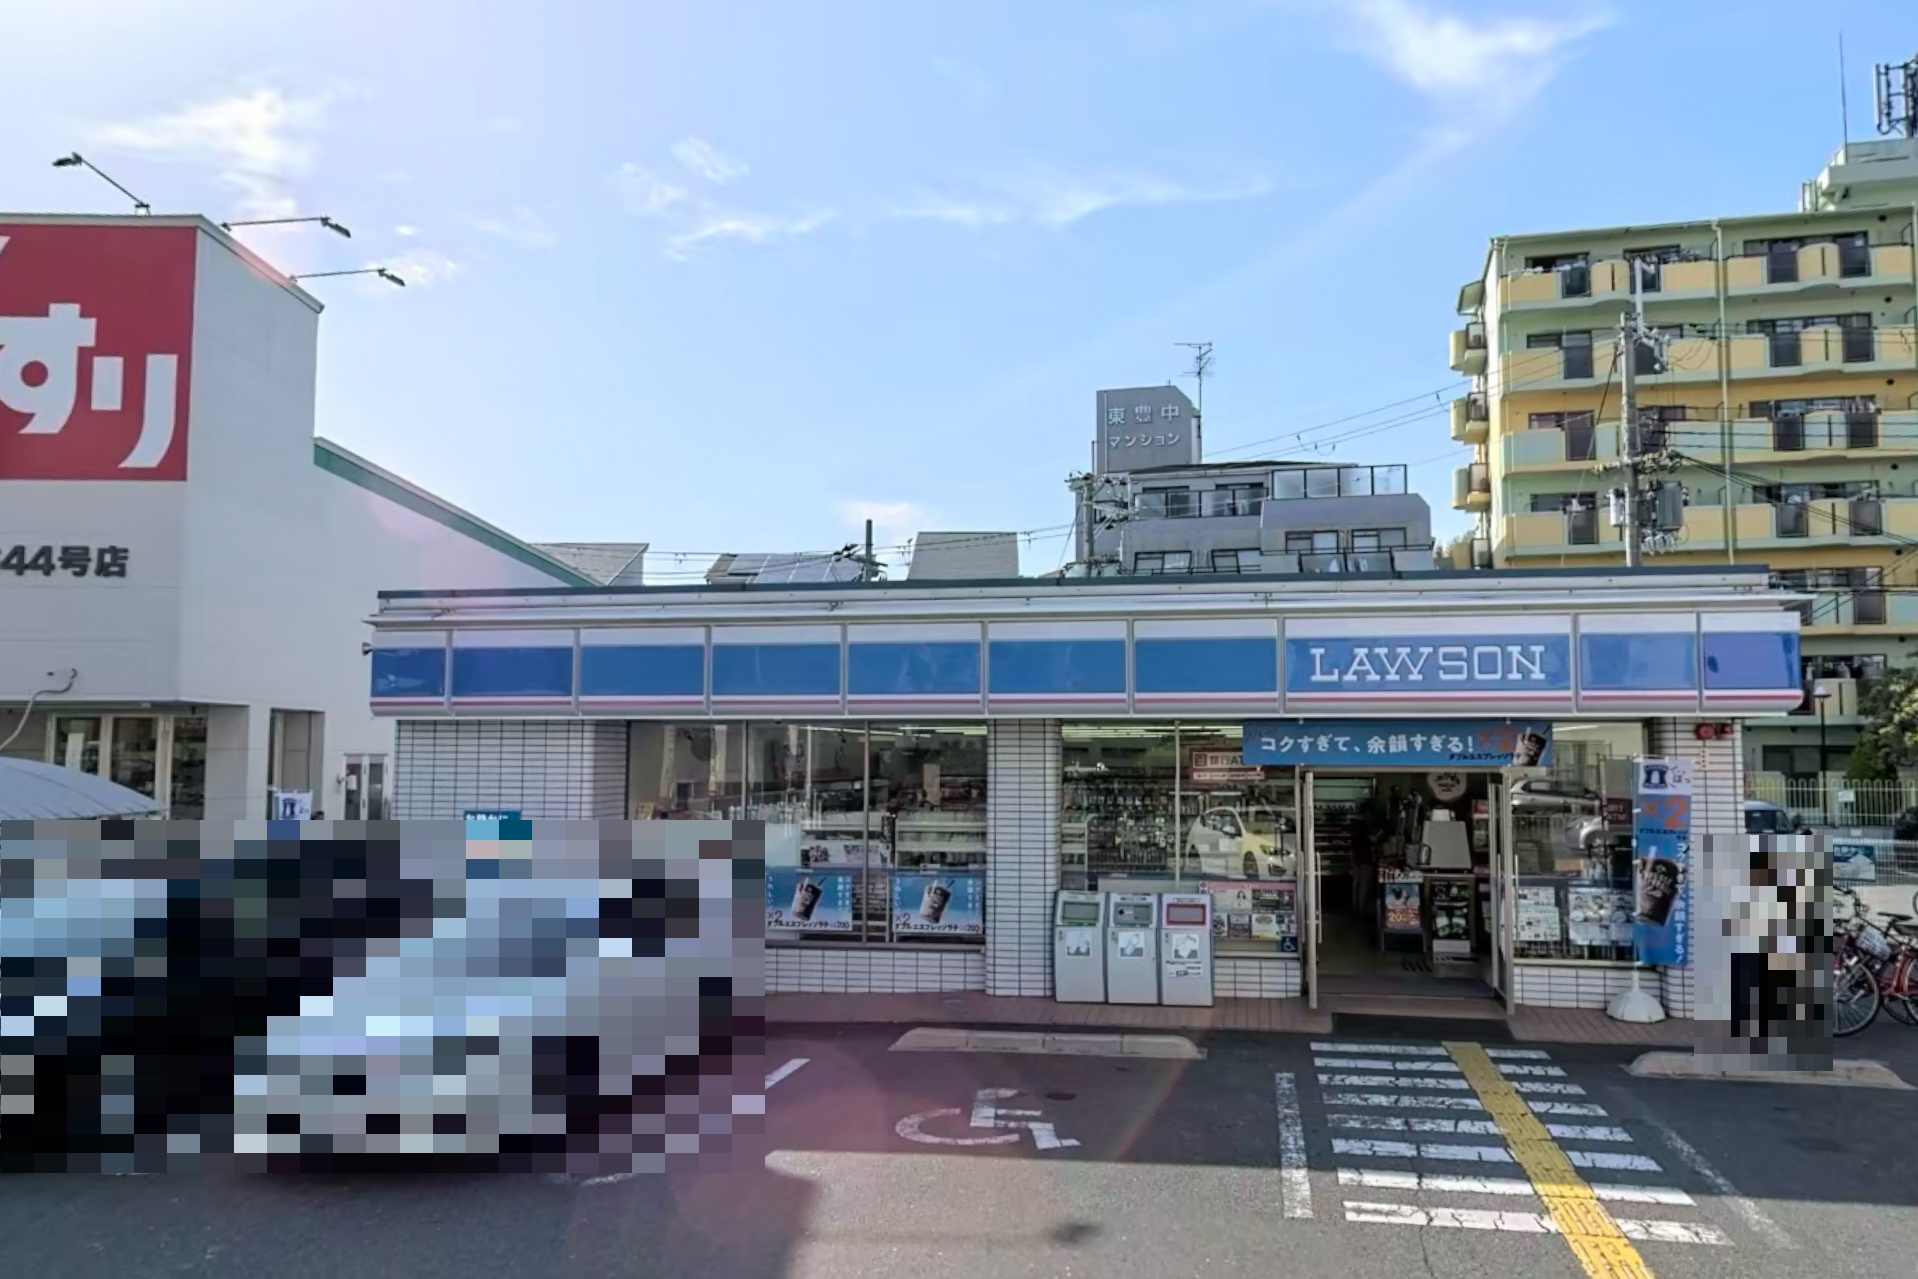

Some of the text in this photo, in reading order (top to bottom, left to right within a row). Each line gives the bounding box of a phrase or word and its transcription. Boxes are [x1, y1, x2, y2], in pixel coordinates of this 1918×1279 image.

[1108, 403, 1180, 426] 東豊中
[1109, 433, 1180, 448] マンション
[0, 545, 129, 577] 44号店
[1310, 645, 1546, 682] LAWSON
